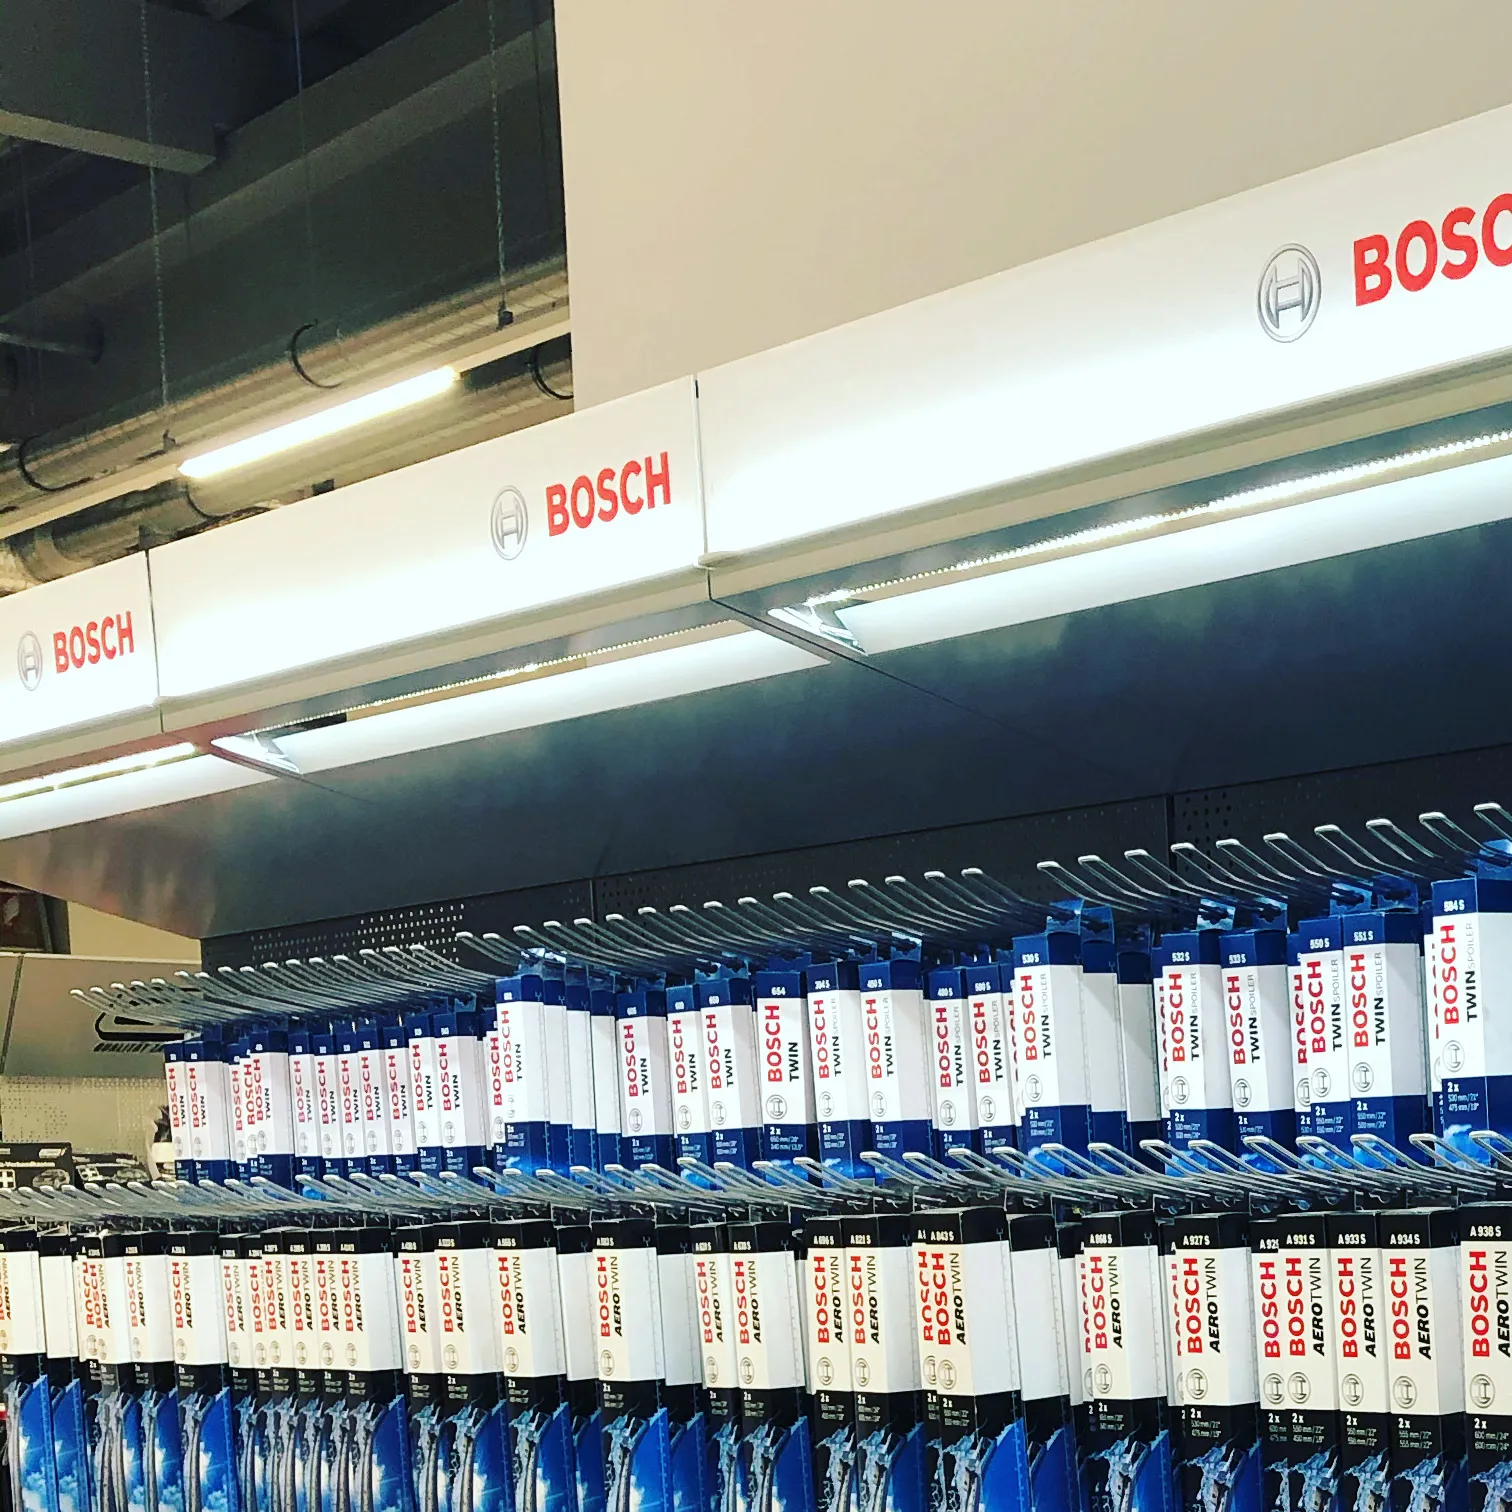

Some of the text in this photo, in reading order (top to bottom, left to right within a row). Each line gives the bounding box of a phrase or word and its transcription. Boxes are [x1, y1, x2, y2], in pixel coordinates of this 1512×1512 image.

[546, 452, 670, 536] BOSCH
[54, 613, 134, 672] BOSCH
[1351, 954, 1368, 1047] BOSCH
[503, 1010, 513, 1082] BOSCH
[765, 1005, 782, 1082] BOSCH
[788, 1043, 799, 1082] TWIN
[168, 1068, 180, 1128] BOSCH
[1470, 1226, 1476, 1236] A
[498, 1257, 514, 1334] BOSCH
[513, 1257, 526, 1334] AEROTWIN
[1184, 1258, 1202, 1353] BOSCH
[1205, 1258, 1220, 1353] AEROTWIN
[1470, 1251, 1490, 1356] BOSCH
[1495, 1251, 1510, 1357] AEROTWIN
